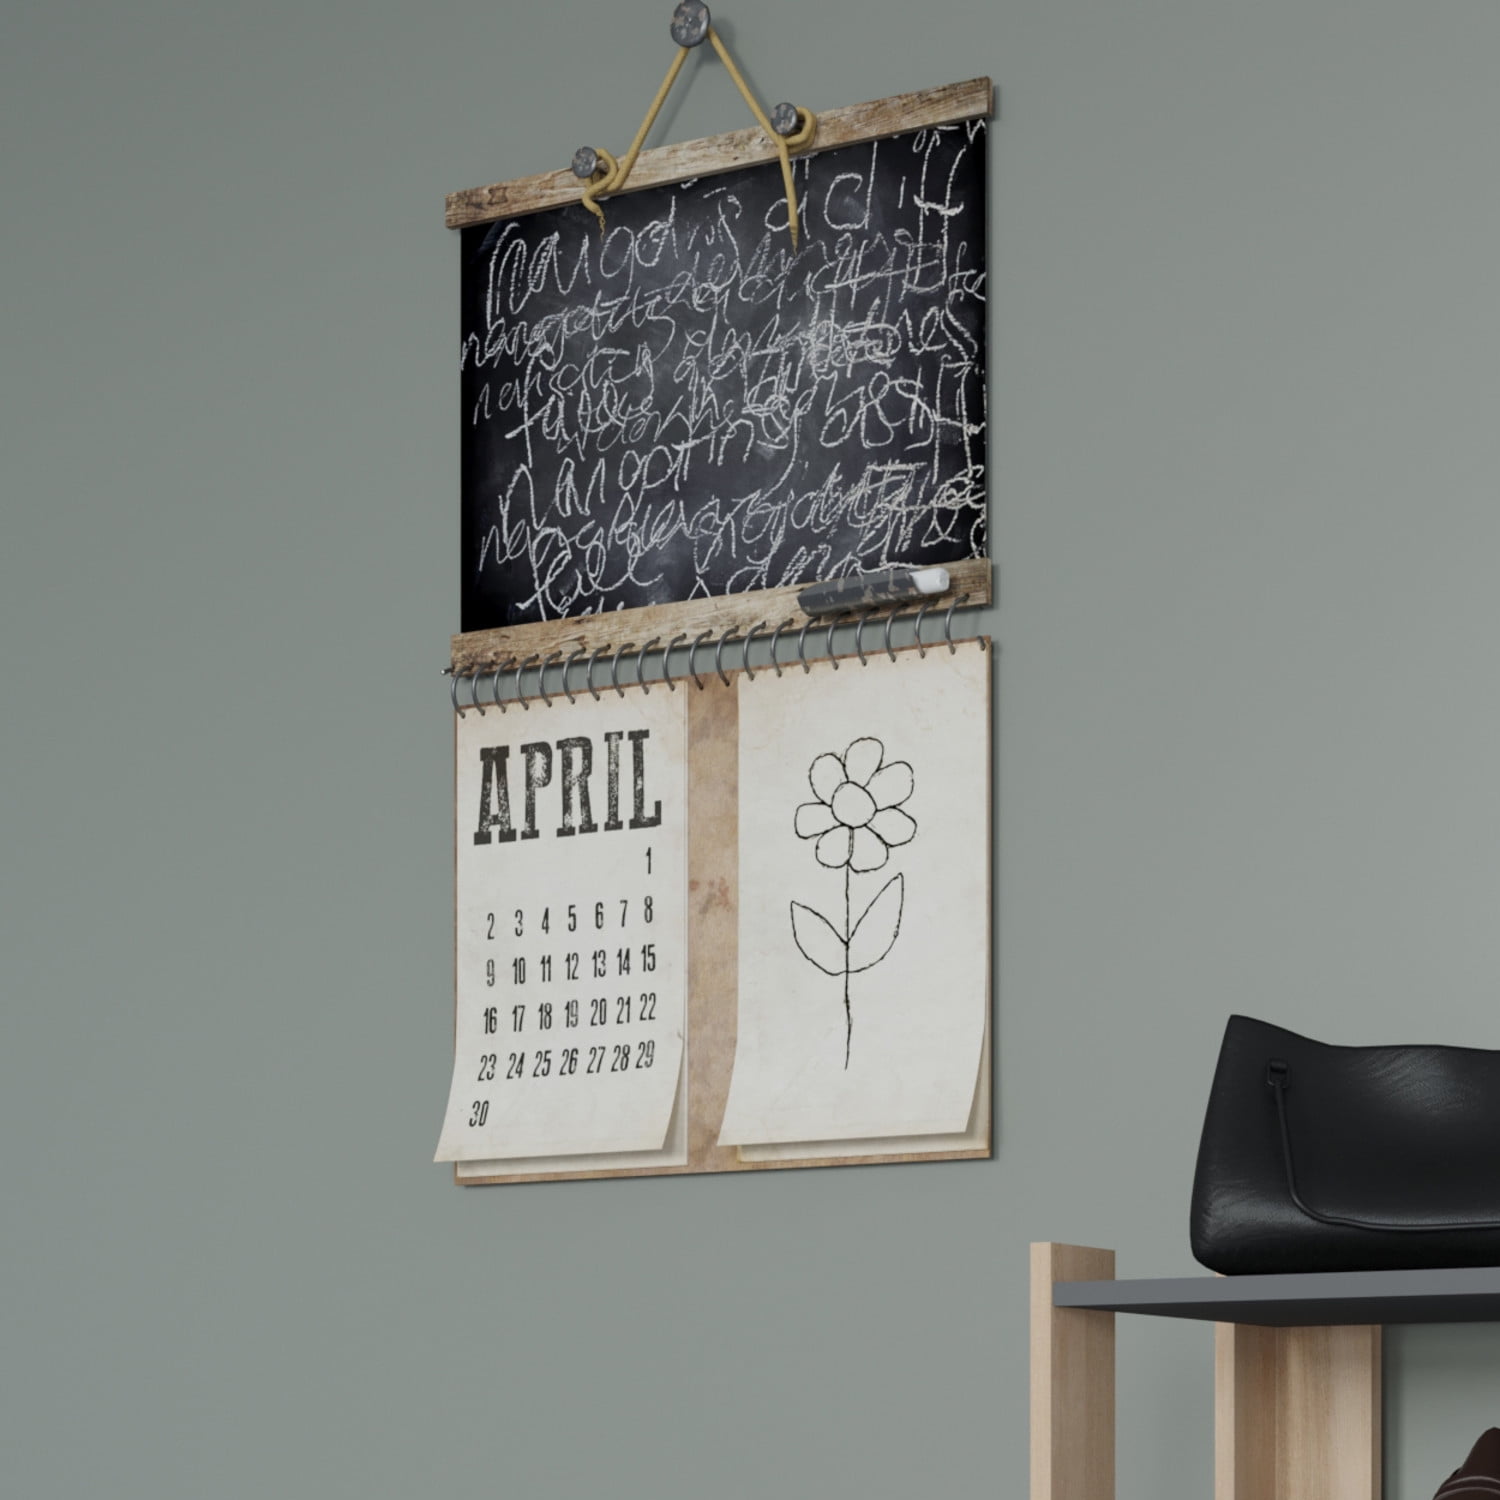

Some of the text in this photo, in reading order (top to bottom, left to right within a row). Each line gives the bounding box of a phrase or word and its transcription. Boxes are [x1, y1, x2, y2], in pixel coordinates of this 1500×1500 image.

[473, 728, 662, 846] APRIL
[645, 846, 652, 875] 1
[486, 895, 653, 941] 2 3 4 5 6 7 8
[486, 943, 656, 987] 9 10 11 12 13 14 15
[483, 992, 657, 1035] 16 17 18 19 20 21 22
[477, 1040, 655, 1082] 23 24 25 26 27 28 29
[468, 1100, 490, 1128] 30
